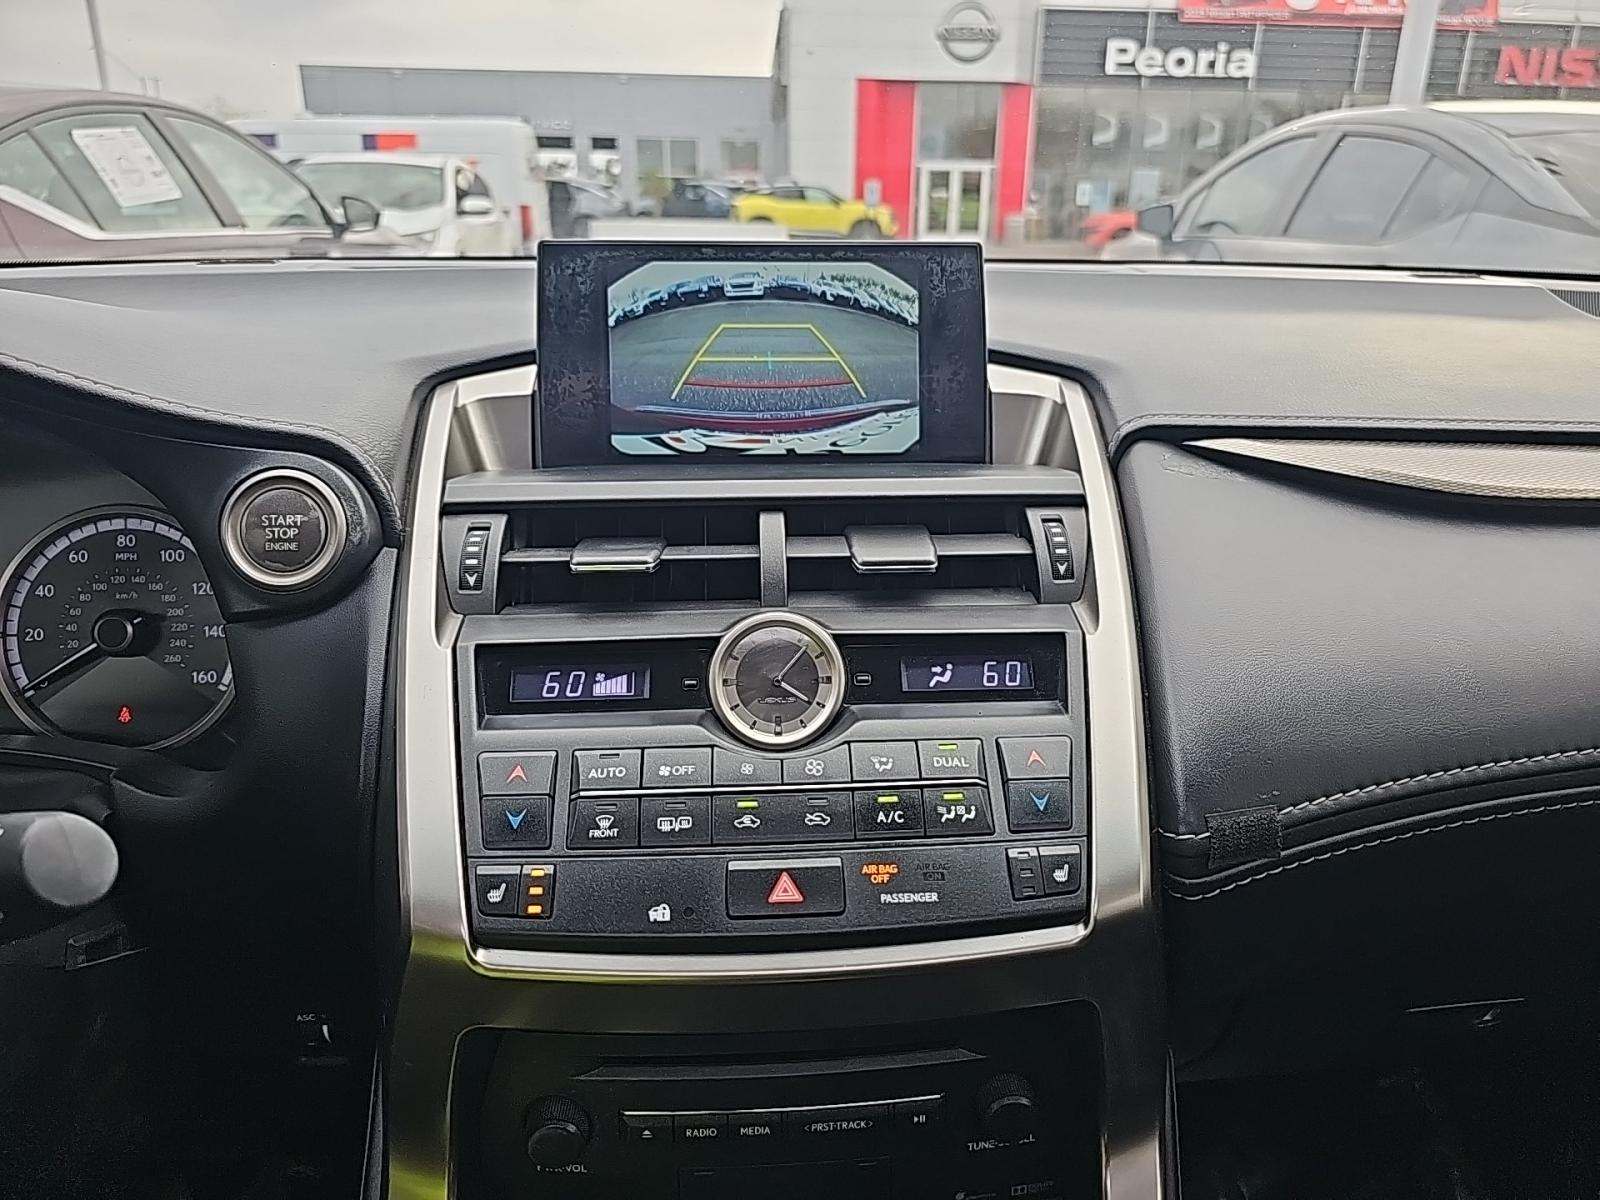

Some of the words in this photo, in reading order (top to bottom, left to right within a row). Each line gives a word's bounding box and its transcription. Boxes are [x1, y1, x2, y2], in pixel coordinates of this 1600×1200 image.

[1105, 37, 1257, 79] Peoria
[261, 514, 303, 527] START
[265, 527, 299, 539] STOP
[116, 534, 136, 547] 80
[265, 542, 299, 551] ENGINE
[68, 550, 88, 563] 60
[115, 552, 138, 562] MPH
[160, 549, 185, 562] 100
[111, 576, 126, 584] 120
[131, 575, 146, 583] 140
[35, 584, 54, 597] 40
[92, 583, 108, 591] 100
[148, 582, 163, 591] 160
[79, 593, 91, 602] 80
[115, 591, 139, 600] km/h
[161, 594, 176, 602] 180
[69, 608, 81, 616] 60
[167, 608, 184, 616] 200
[65, 623, 77, 632] 40
[171, 623, 188, 631] 220
[25, 628, 44, 641] 20
[67, 640, 79, 649] 20
[169, 638, 187, 647] 240
[163, 654, 181, 663] 260
[191, 671, 217, 684] 160
[982, 661, 1022, 687] 60
[541, 670, 586, 698] 60
[933, 756, 970, 768] DUAL
[588, 766, 626, 778] AUTO
[671, 765, 696, 776] OFF
[877, 810, 905, 824] A/C
[588, 828, 620, 839] FRONT
[861, 864, 878, 874] AIR
[878, 864, 898, 874] BAG
[915, 864, 931, 872] AIR
[870, 874, 891, 884] OFF
[926, 872, 942, 881] ON
[880, 892, 939, 904] PASSENGER
[686, 1128, 717, 1138] RADIO
[740, 1126, 771, 1136] MEDIA
